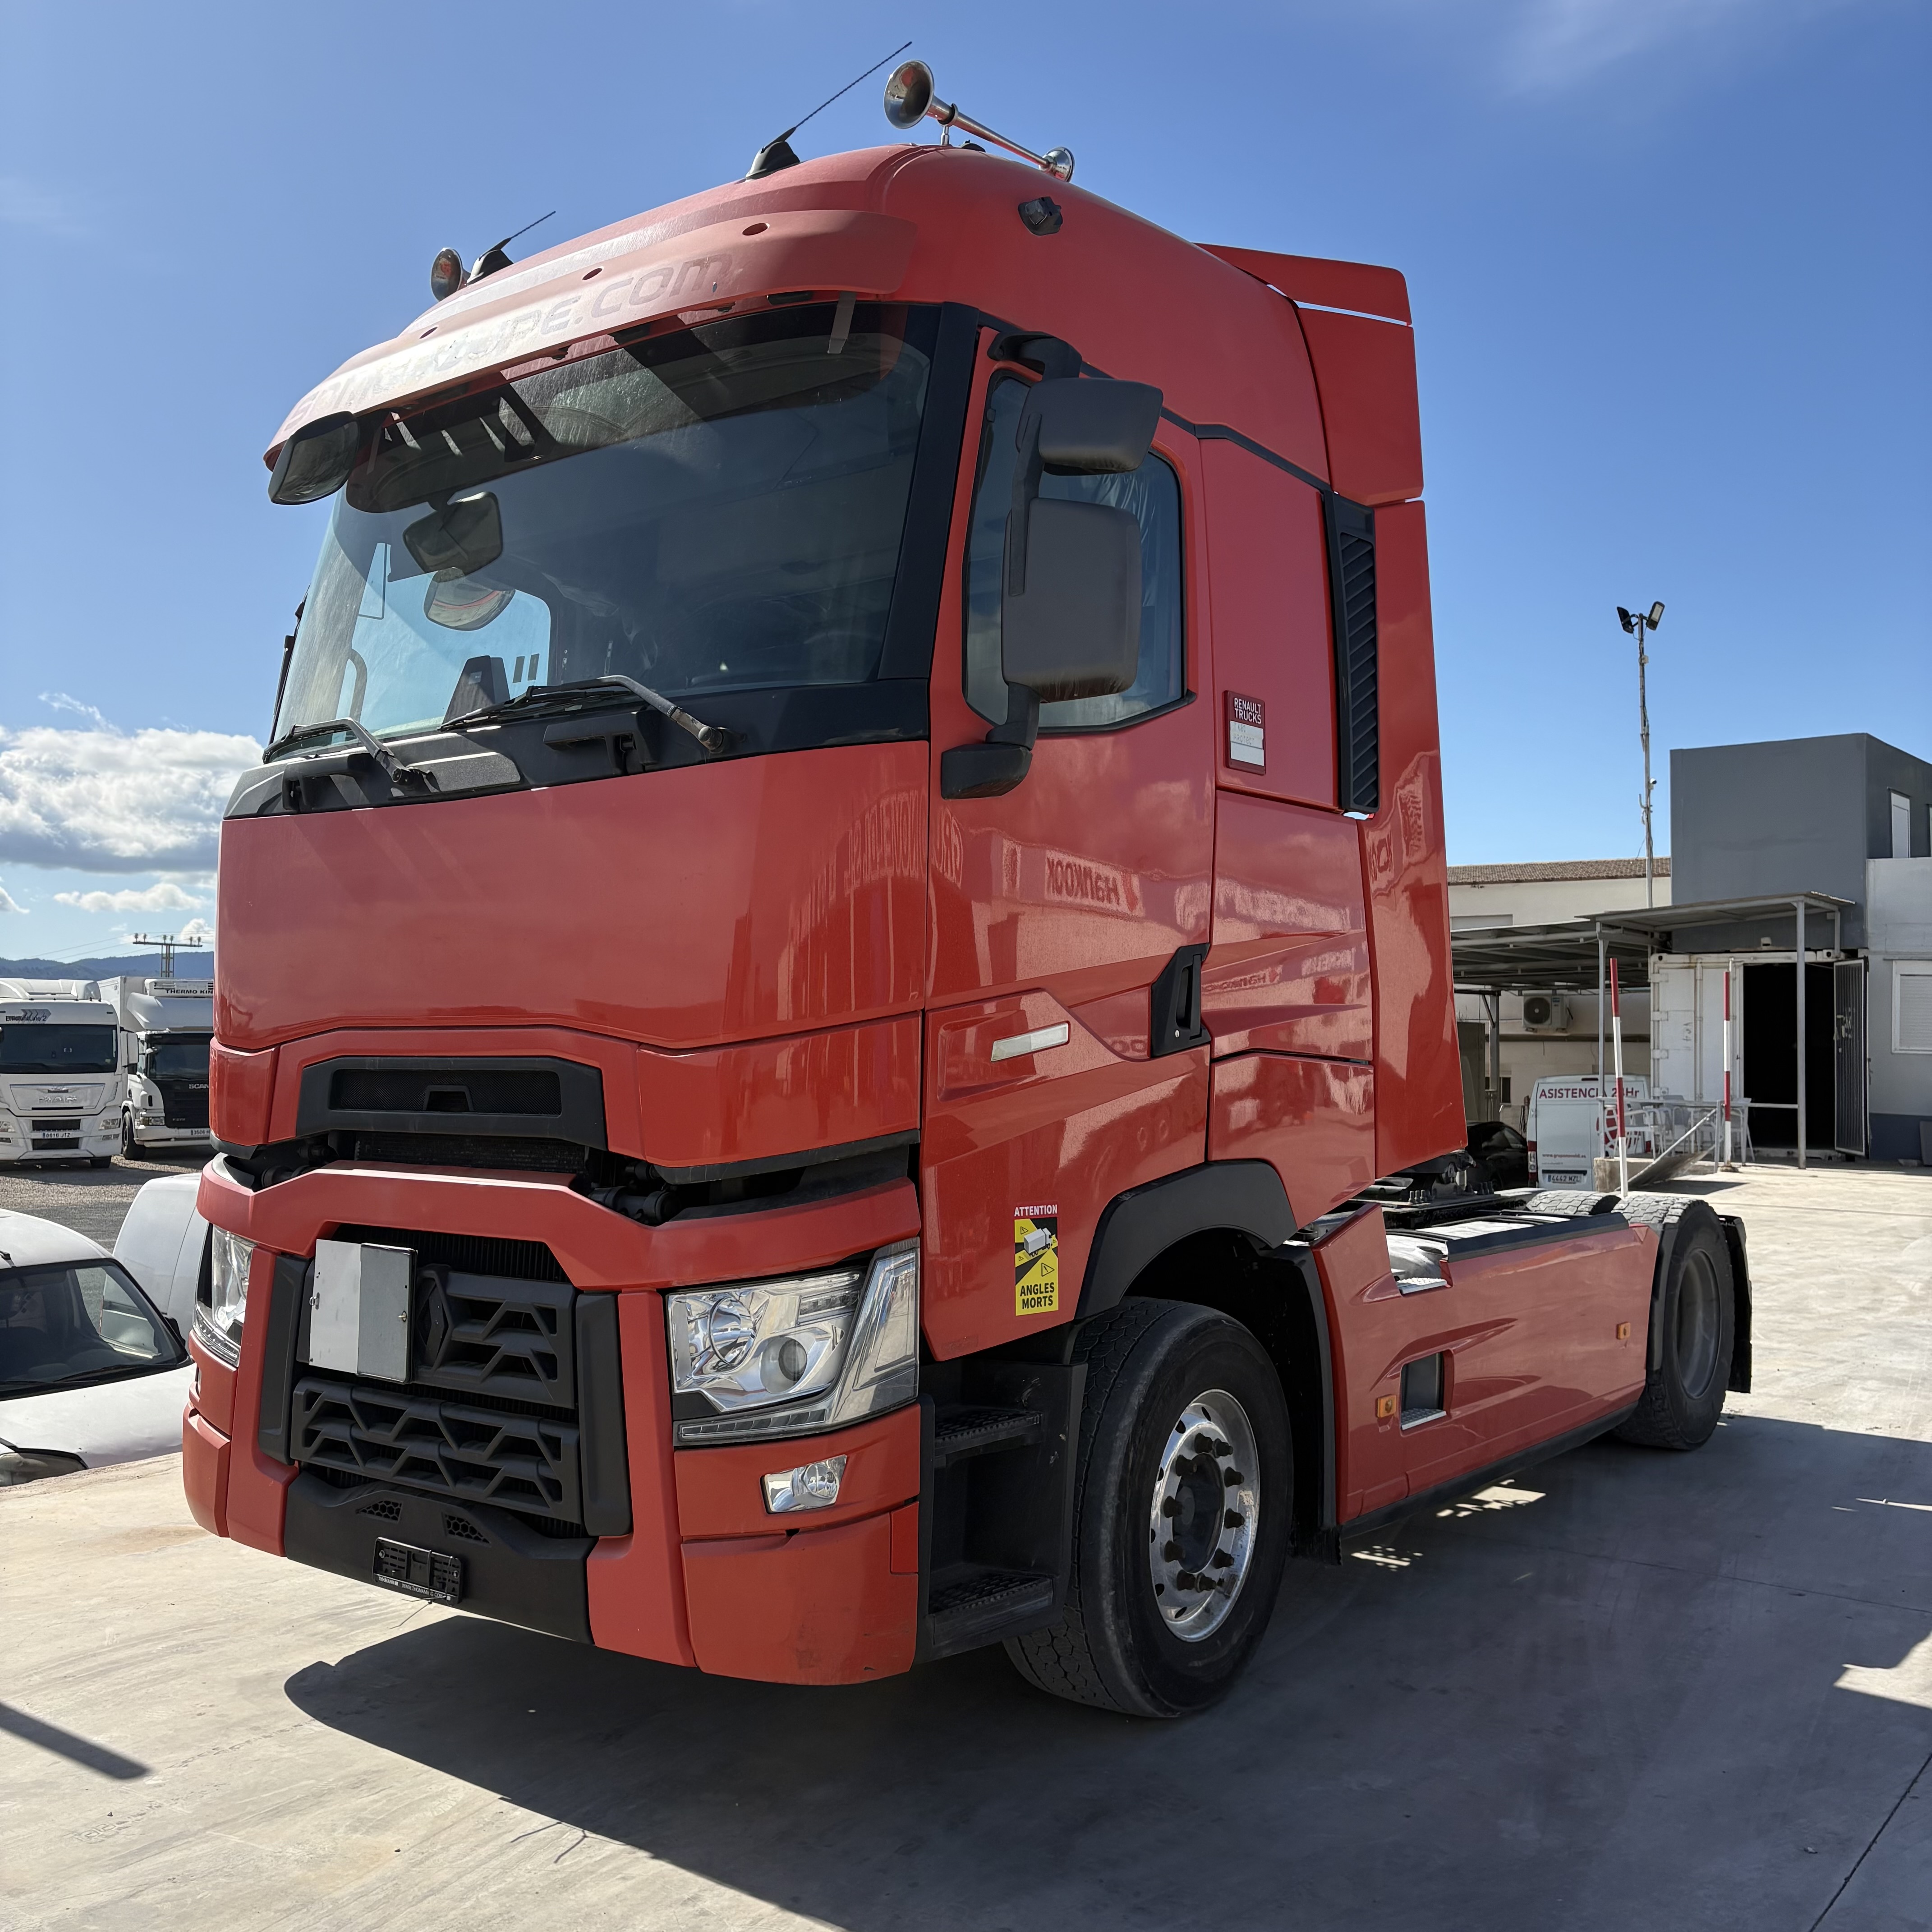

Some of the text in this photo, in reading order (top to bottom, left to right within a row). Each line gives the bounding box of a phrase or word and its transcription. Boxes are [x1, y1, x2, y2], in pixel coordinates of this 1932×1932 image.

[1234, 697, 1261, 714] RENAULT
[1234, 708, 1262, 724] TRUCKS
[1539, 1087, 1640, 1099] ASISTENCI 2Hr
[1014, 1204, 1058, 1217] ATTENTION
[1020, 1282, 1055, 1297] ANGLES
[1022, 1295, 1053, 1310] MORTS
